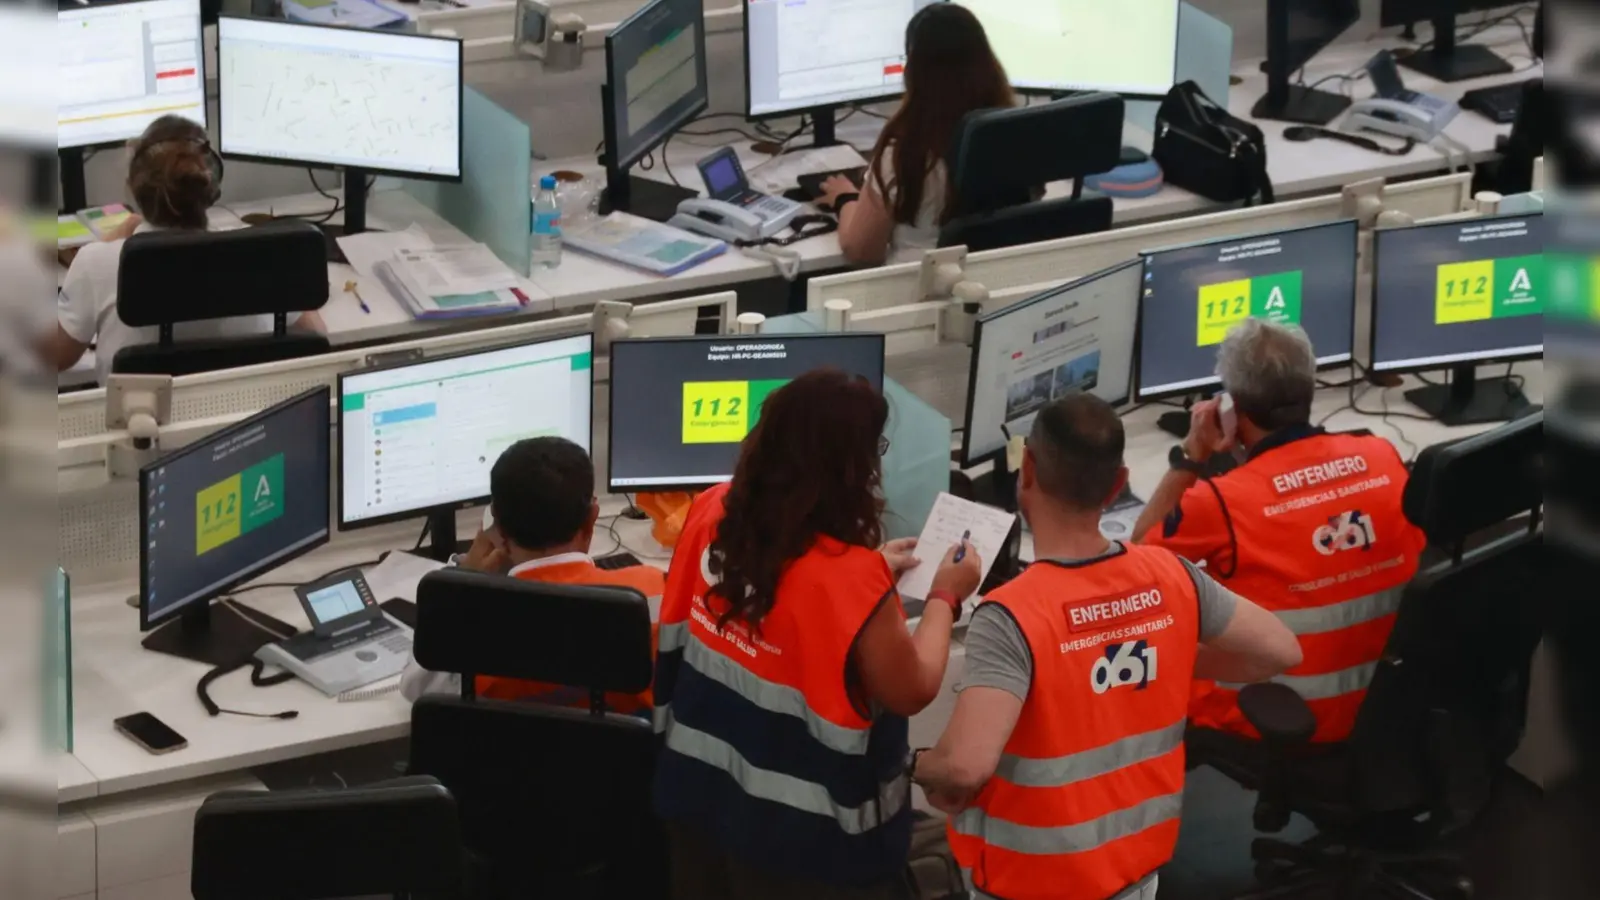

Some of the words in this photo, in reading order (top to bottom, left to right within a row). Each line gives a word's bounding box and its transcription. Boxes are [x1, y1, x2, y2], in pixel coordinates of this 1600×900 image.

[1445, 275, 1488, 299] 112
[1204, 295, 1245, 319] 112
[692, 396, 742, 417] 112
[1272, 455, 1368, 493] ENFERMERO
[202, 491, 236, 524] 112
[1263, 489, 1338, 517] EMERGENCIAS
[1069, 588, 1162, 625] ENFERMERO
[1090, 640, 1158, 695] 061
